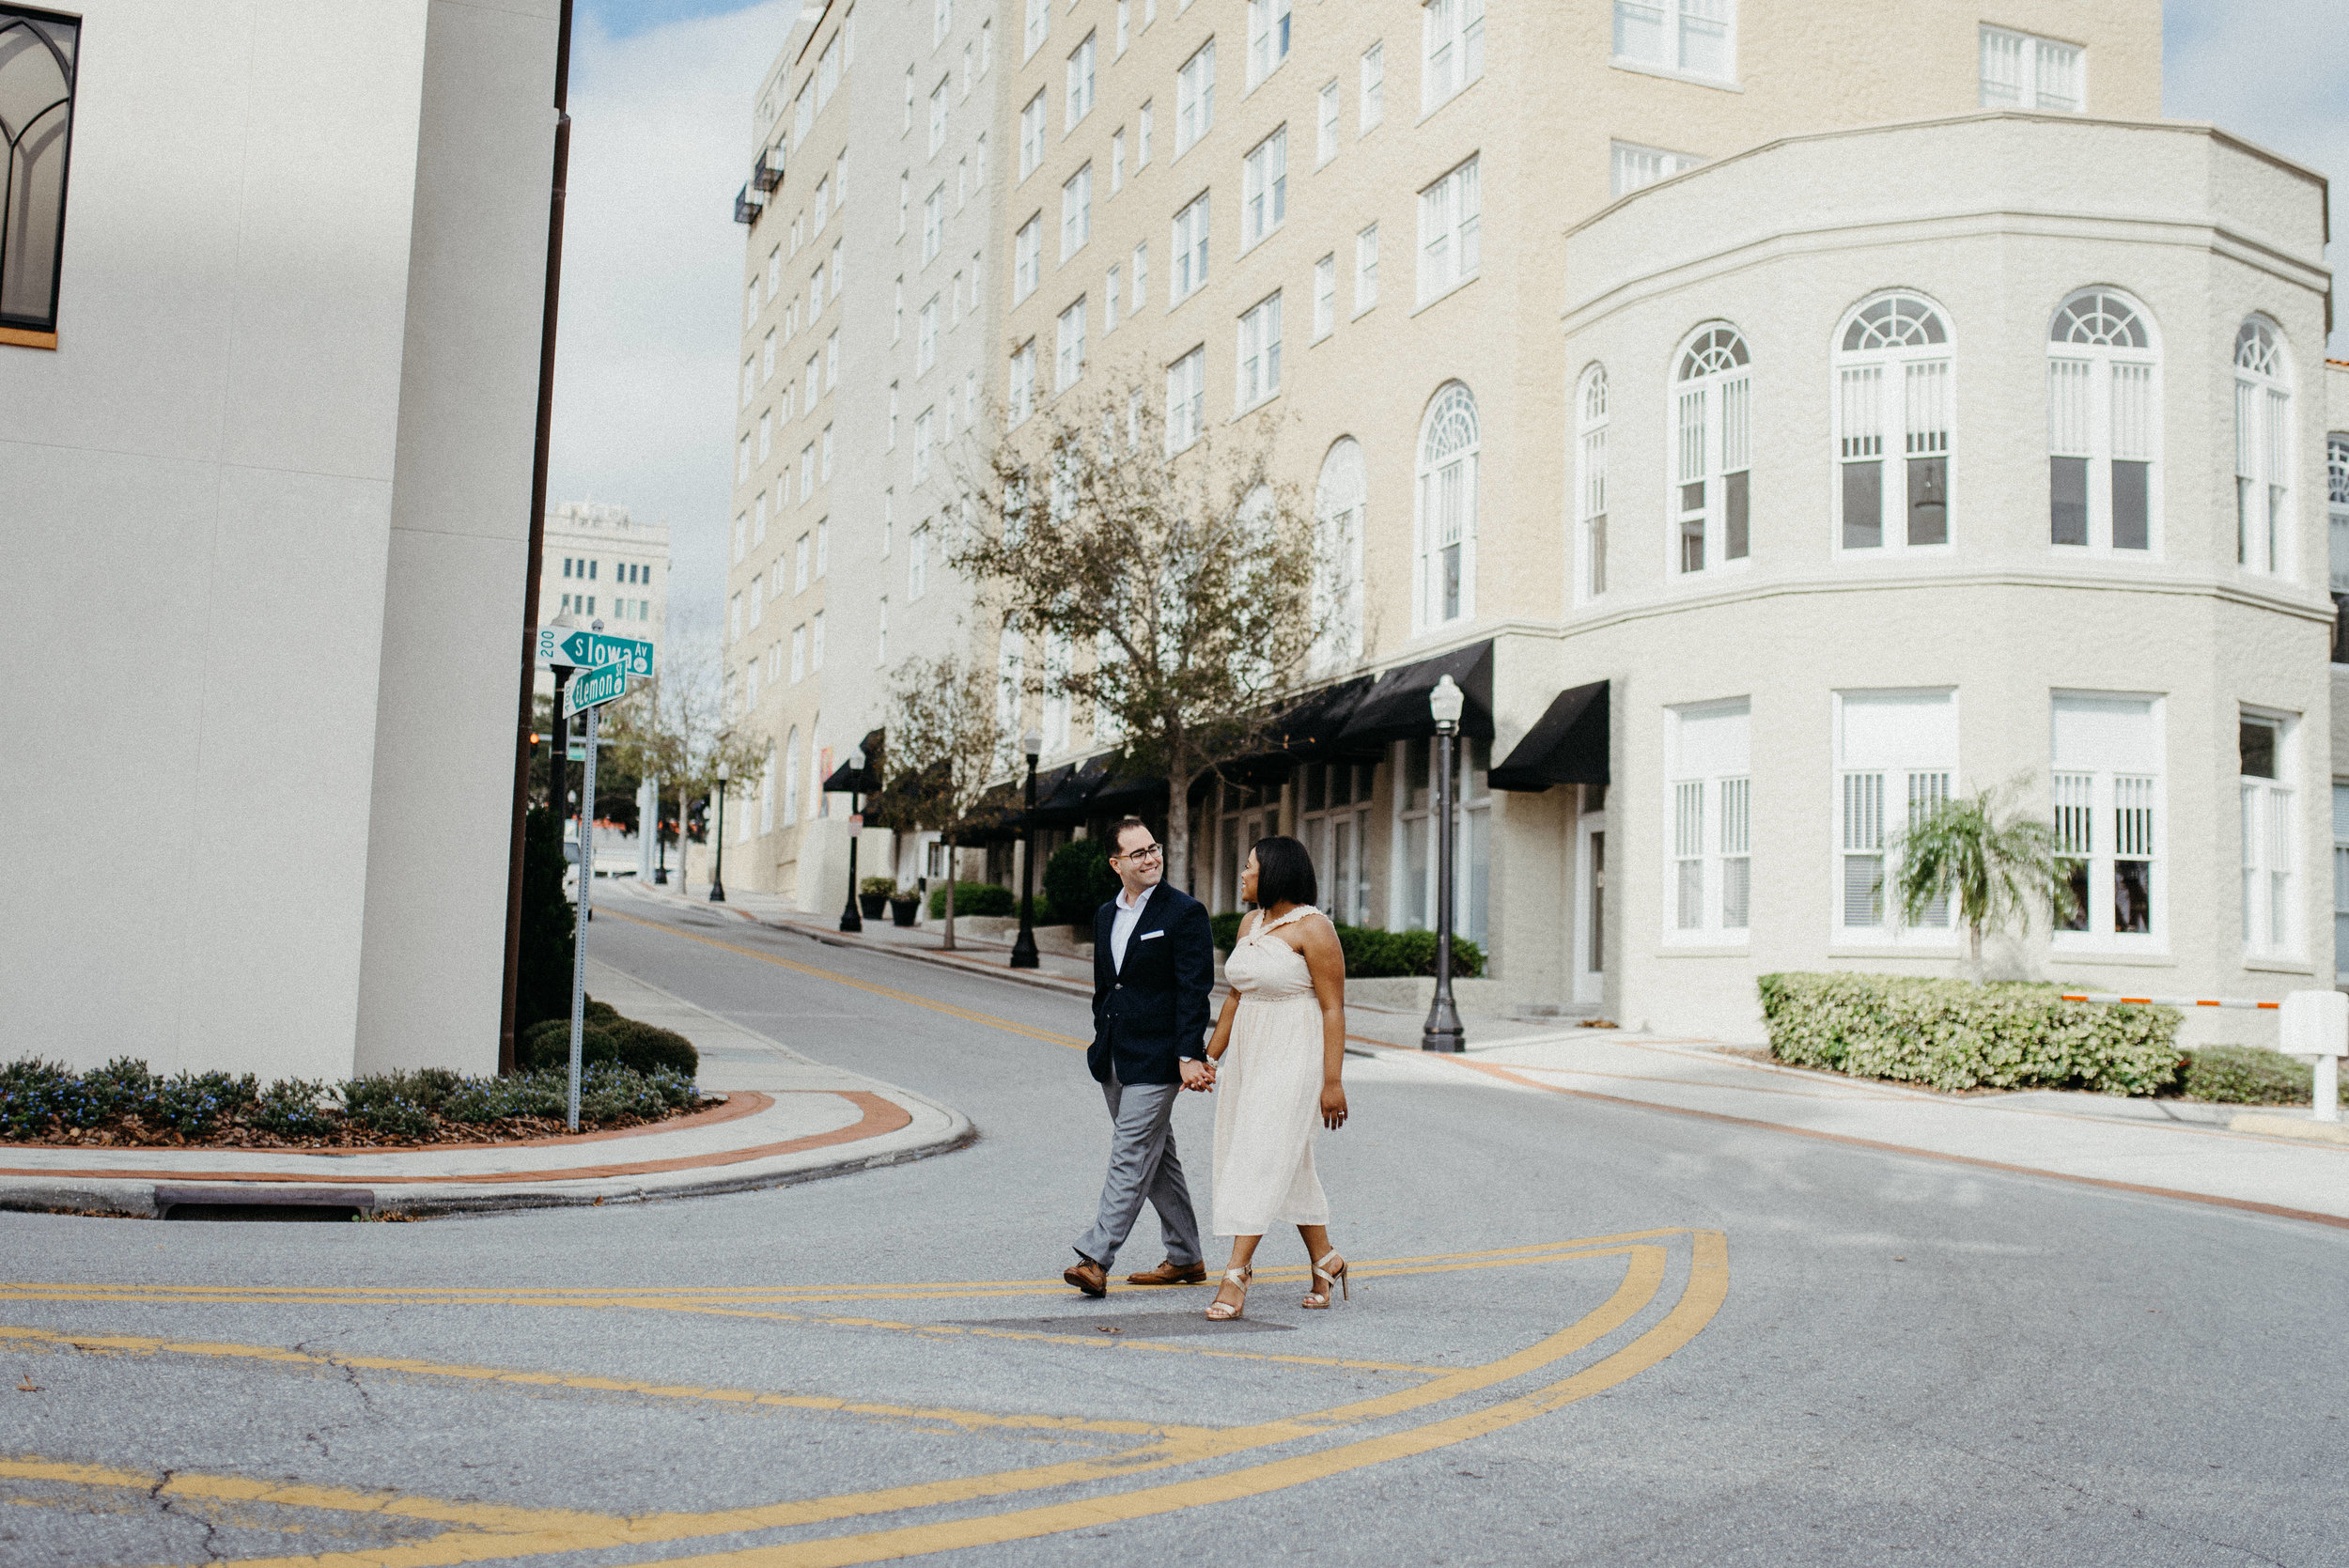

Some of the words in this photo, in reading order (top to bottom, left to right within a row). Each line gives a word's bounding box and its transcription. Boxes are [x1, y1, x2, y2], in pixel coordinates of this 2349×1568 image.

[540, 630, 554, 658] 200
[575, 639, 583, 657] S
[588, 637, 632, 668] Iowa
[634, 643, 647, 657] Av
[579, 674, 612, 706] Lemon
